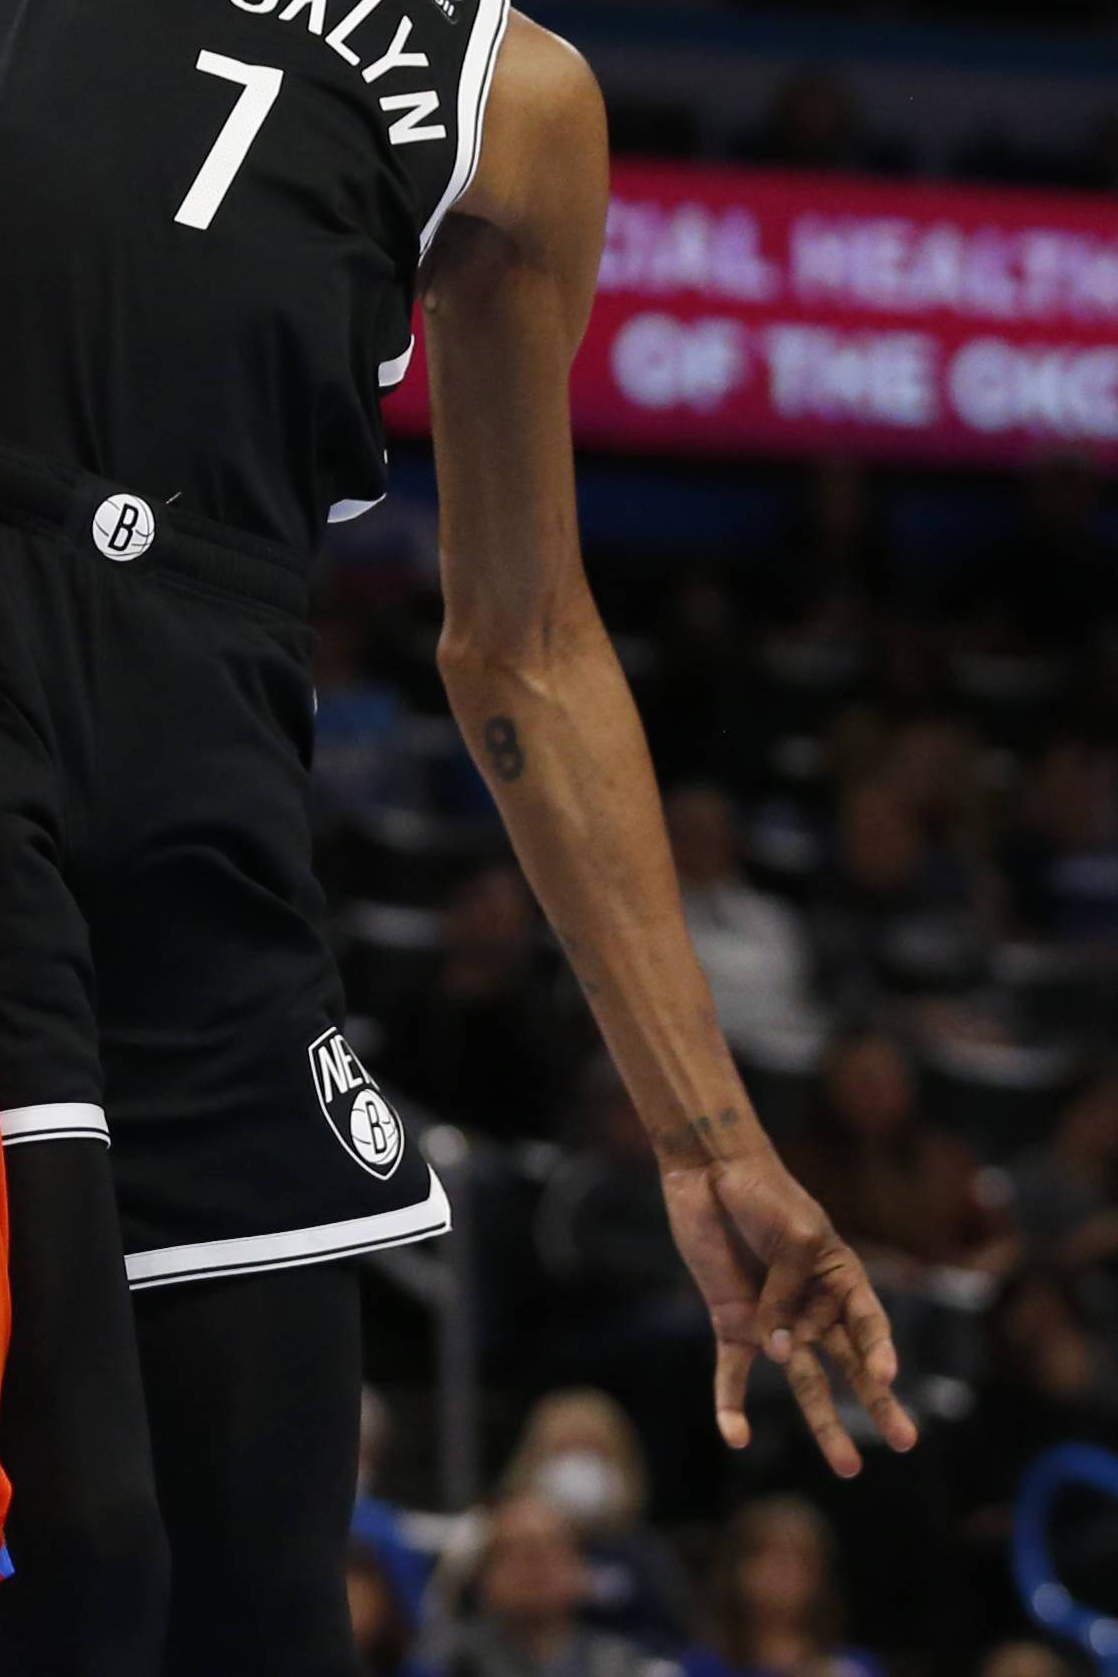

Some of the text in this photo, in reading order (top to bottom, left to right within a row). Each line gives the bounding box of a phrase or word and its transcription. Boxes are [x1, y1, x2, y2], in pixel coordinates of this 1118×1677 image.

[174, 49, 284, 231] 7
[108, 503, 139, 552] B
[318, 1034, 371, 1104] NE
[365, 1100, 387, 1155] B
